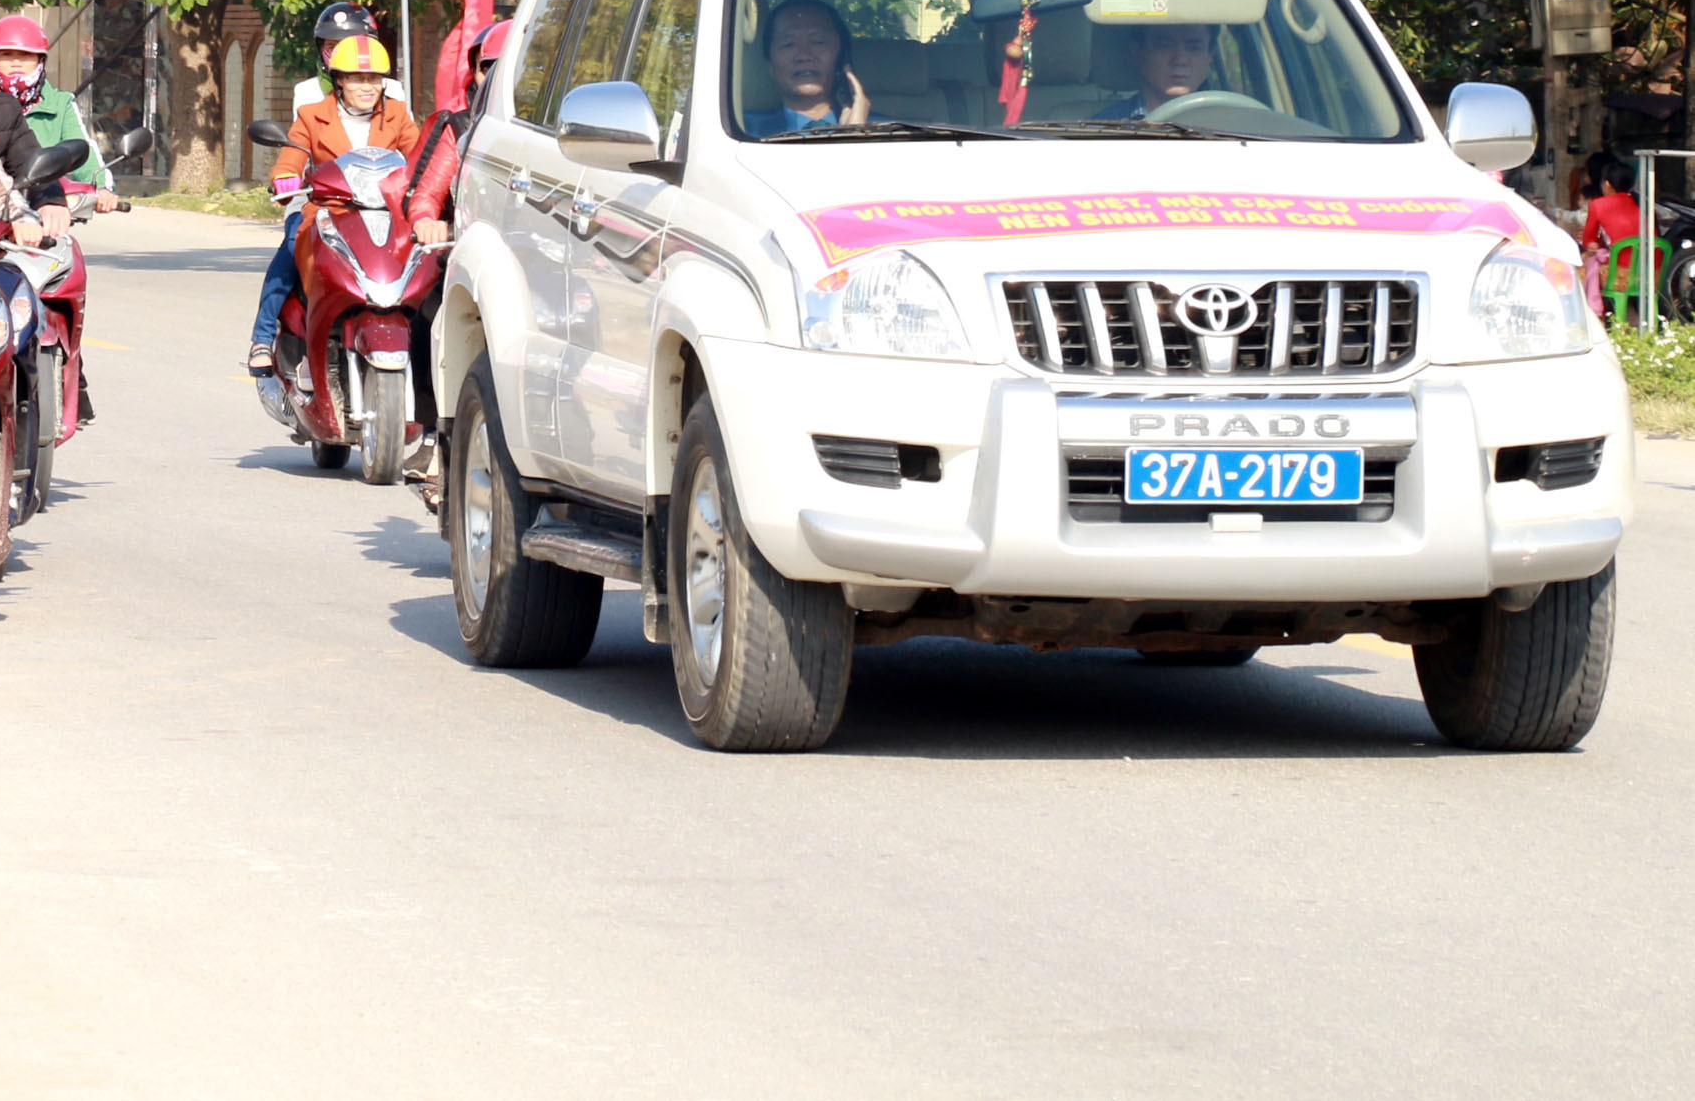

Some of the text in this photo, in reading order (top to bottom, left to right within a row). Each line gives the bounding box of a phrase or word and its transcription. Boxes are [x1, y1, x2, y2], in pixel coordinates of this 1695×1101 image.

[1076, 210, 1160, 226] SINH
[1219, 210, 1280, 224] HAI
[1285, 212, 1358, 226] CON
[1129, 414, 1350, 437] PRADO
[1141, 453, 1335, 498] 37A-2179
